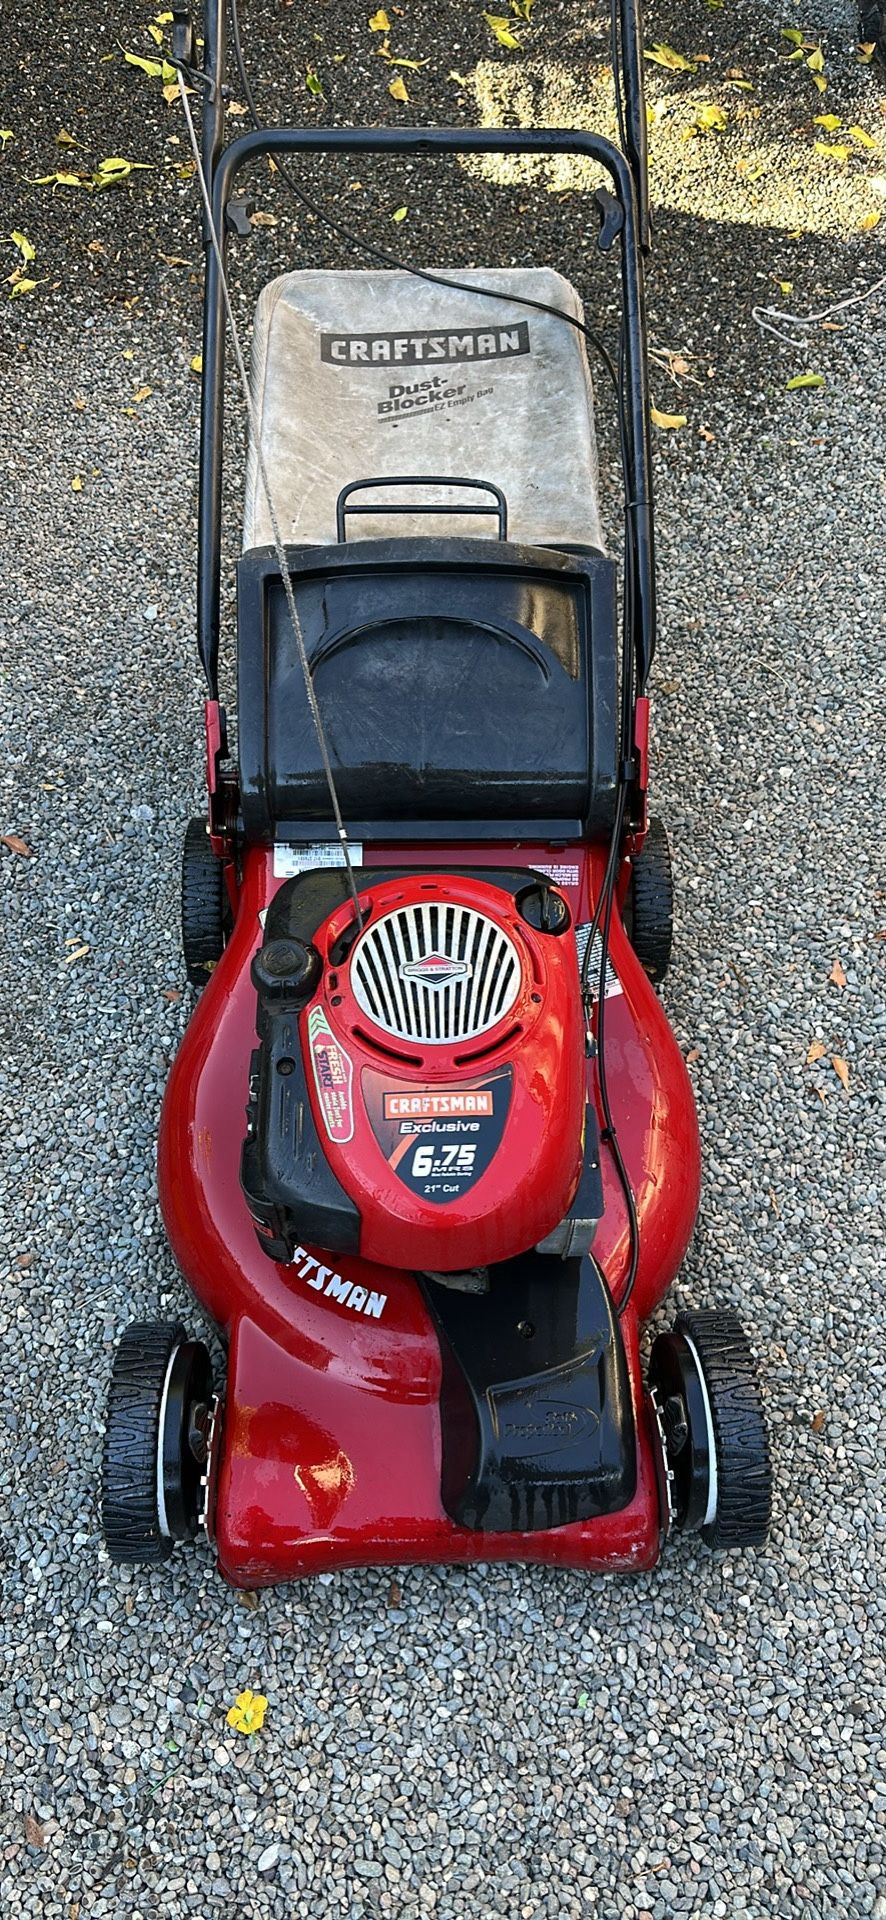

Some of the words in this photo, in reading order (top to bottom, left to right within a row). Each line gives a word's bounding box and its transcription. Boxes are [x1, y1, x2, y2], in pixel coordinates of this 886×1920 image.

[330, 330, 520, 361] CRAFTSMAN
[377, 383, 467, 414] Blocker
[389, 376, 448, 398] Dust-
[434, 401, 446, 412] EZ
[447, 394, 475, 409] Empty
[476, 386, 494, 400] Bag
[318, 1050, 334, 1089] START
[327, 1043, 344, 1085] FRESH
[389, 1096, 488, 1114] CRAFTSMAN
[400, 1120, 480, 1134] Exclusive
[412, 1144, 477, 1177] 6.75
[424, 1184, 441, 1193] 21"
[442, 1184, 460, 1193] Cut
[288, 1246, 388, 1319] FTSMAN
